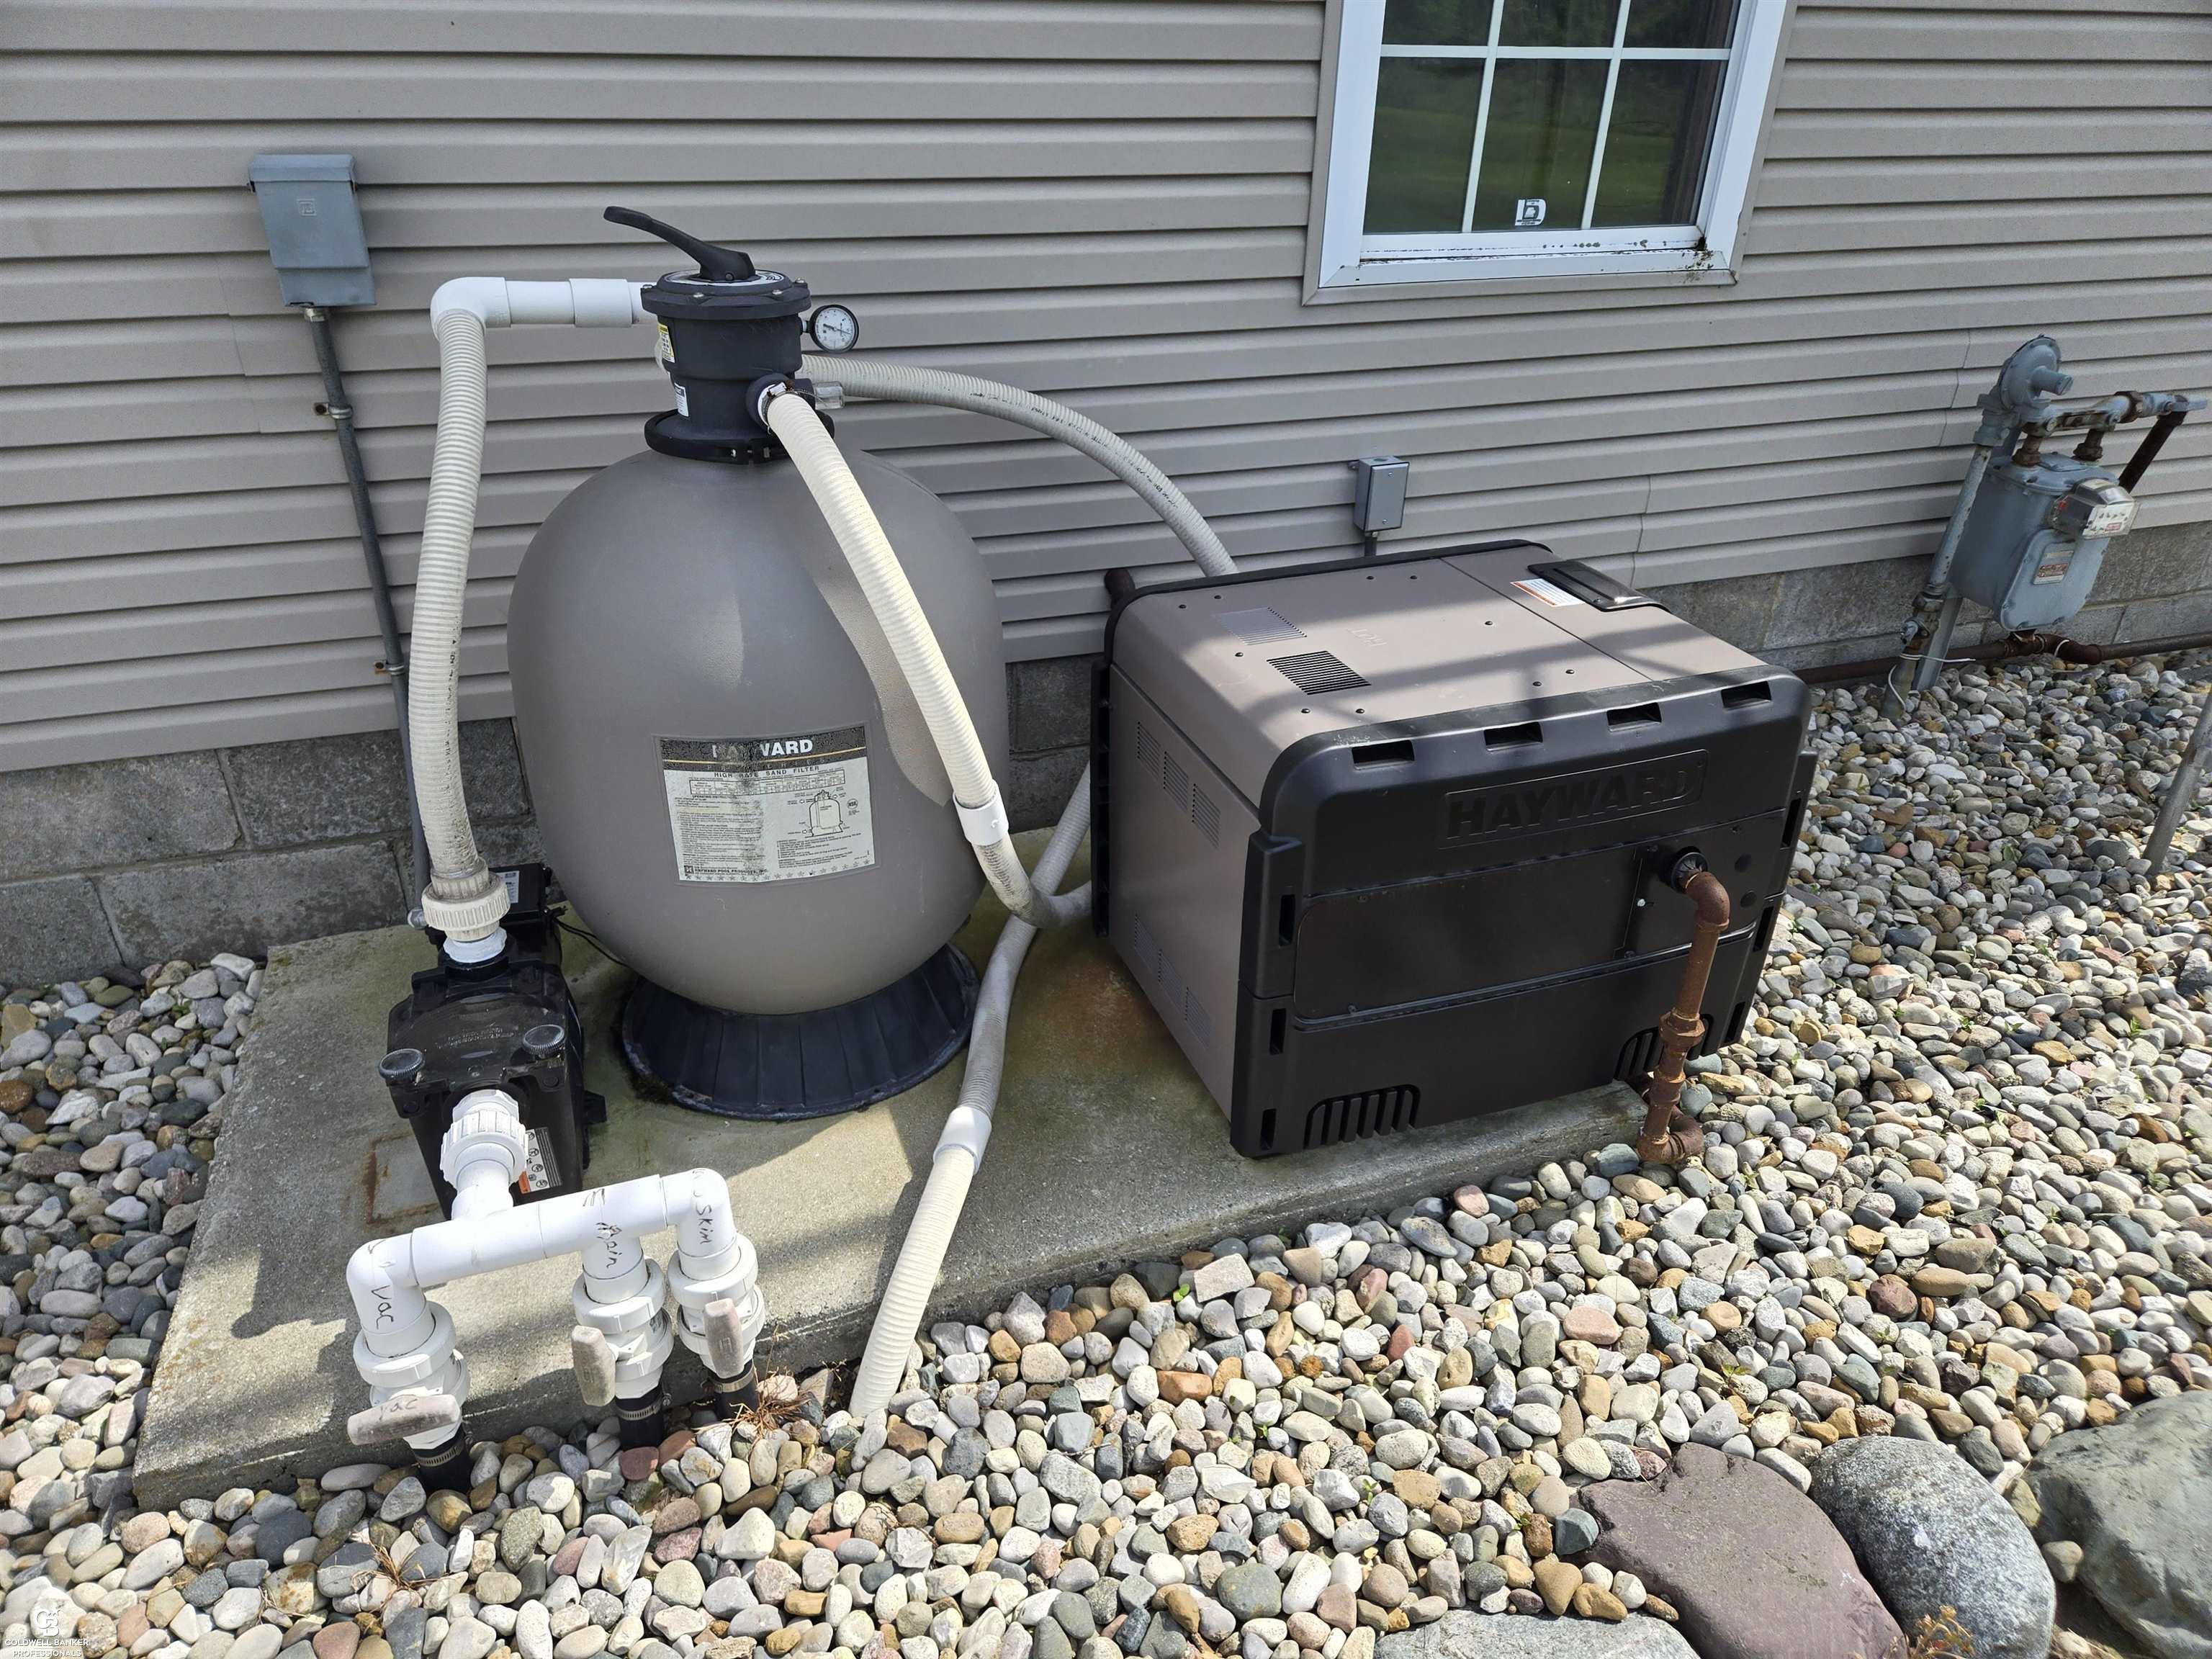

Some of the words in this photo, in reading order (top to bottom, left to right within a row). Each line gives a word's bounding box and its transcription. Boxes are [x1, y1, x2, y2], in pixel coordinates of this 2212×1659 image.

[793, 765, 820, 774] FILTER
[1447, 770, 1689, 840] HAYWARD
[370, 1285, 395, 1330] Vac
